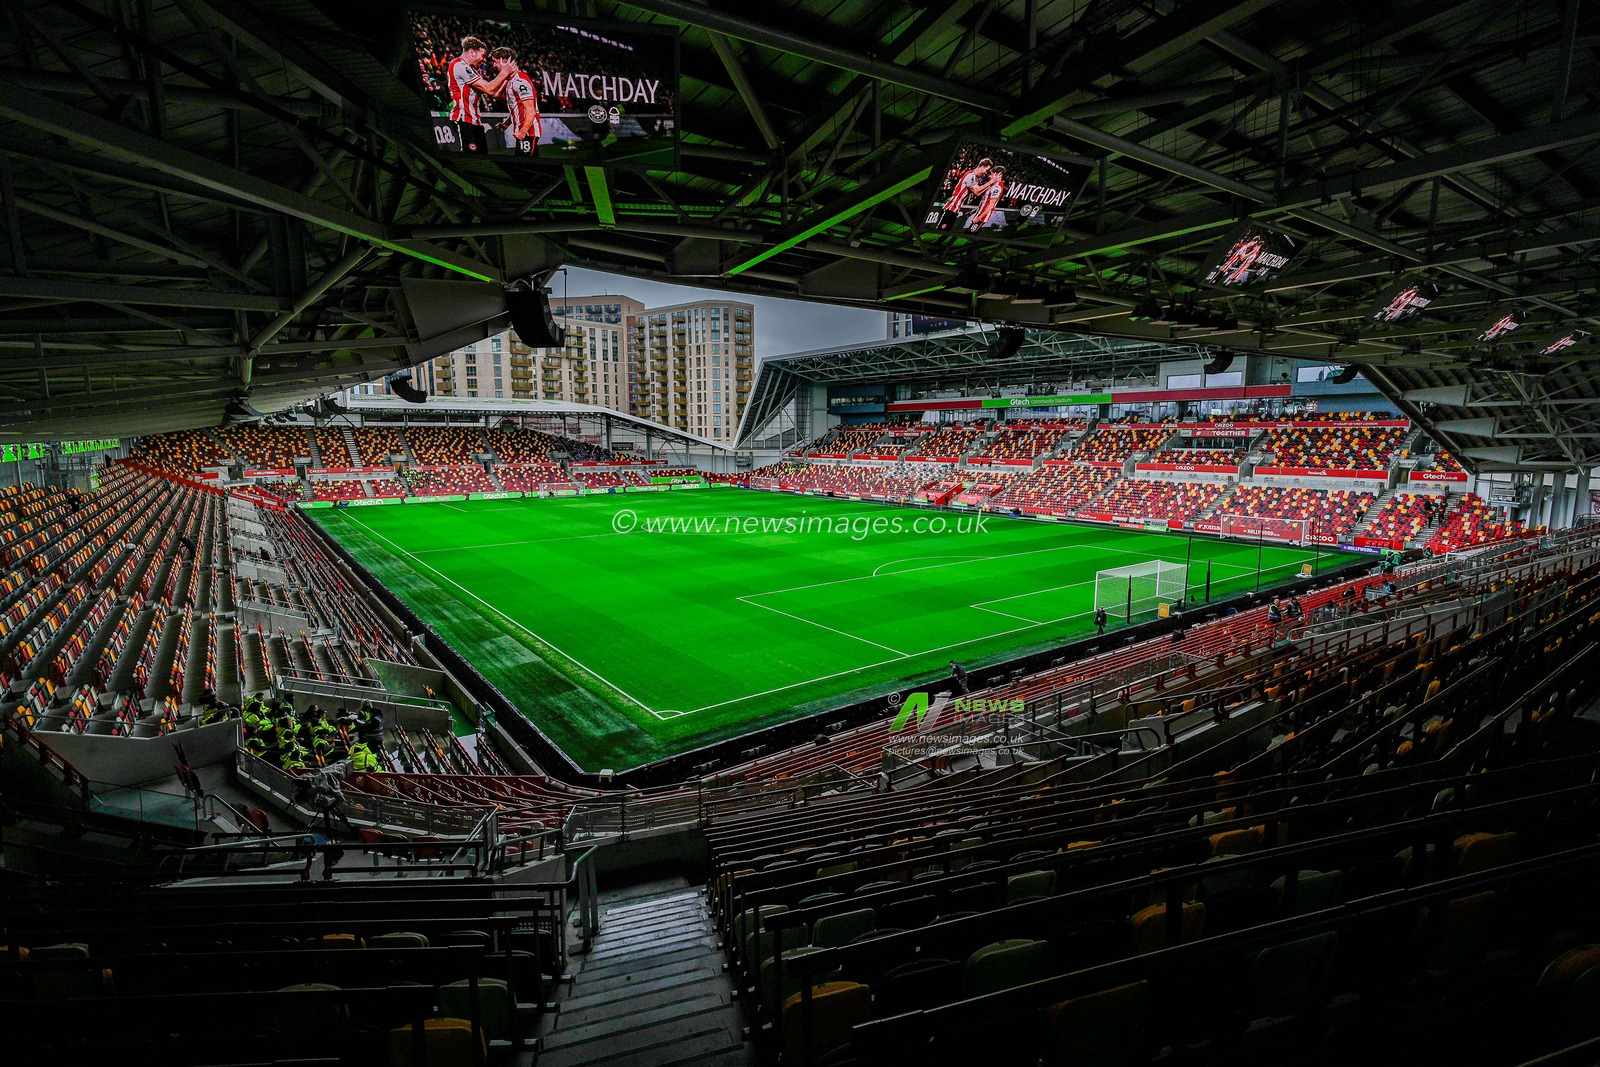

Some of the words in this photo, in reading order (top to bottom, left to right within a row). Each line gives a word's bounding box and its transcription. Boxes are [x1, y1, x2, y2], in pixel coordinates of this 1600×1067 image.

[542, 71, 659, 104] MATCHDAY
[520, 141, 531, 153] 18
[1005, 181, 1071, 207] MATCHDAY
[1254, 251, 1290, 269] MATCHDAY
[1010, 398, 1030, 406] Gtech
